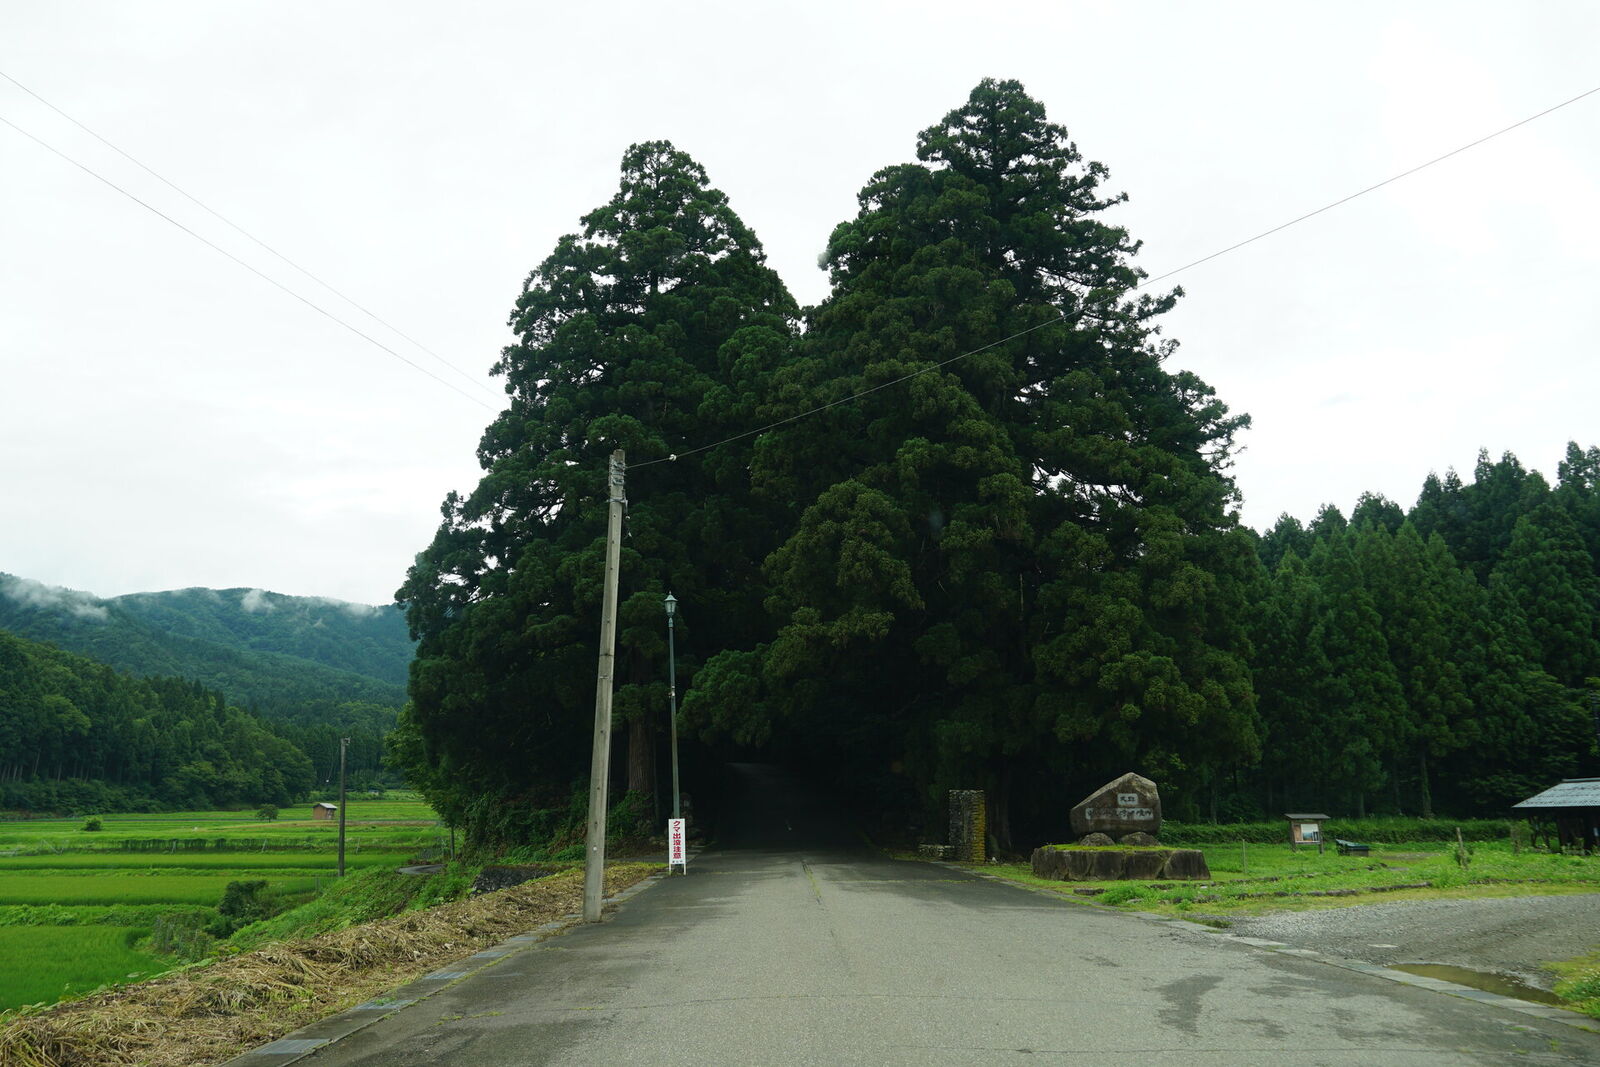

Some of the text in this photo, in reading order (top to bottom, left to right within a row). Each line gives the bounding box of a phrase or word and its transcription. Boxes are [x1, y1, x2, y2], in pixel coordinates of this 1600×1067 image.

[673, 820, 681, 859] クマ出没注意
